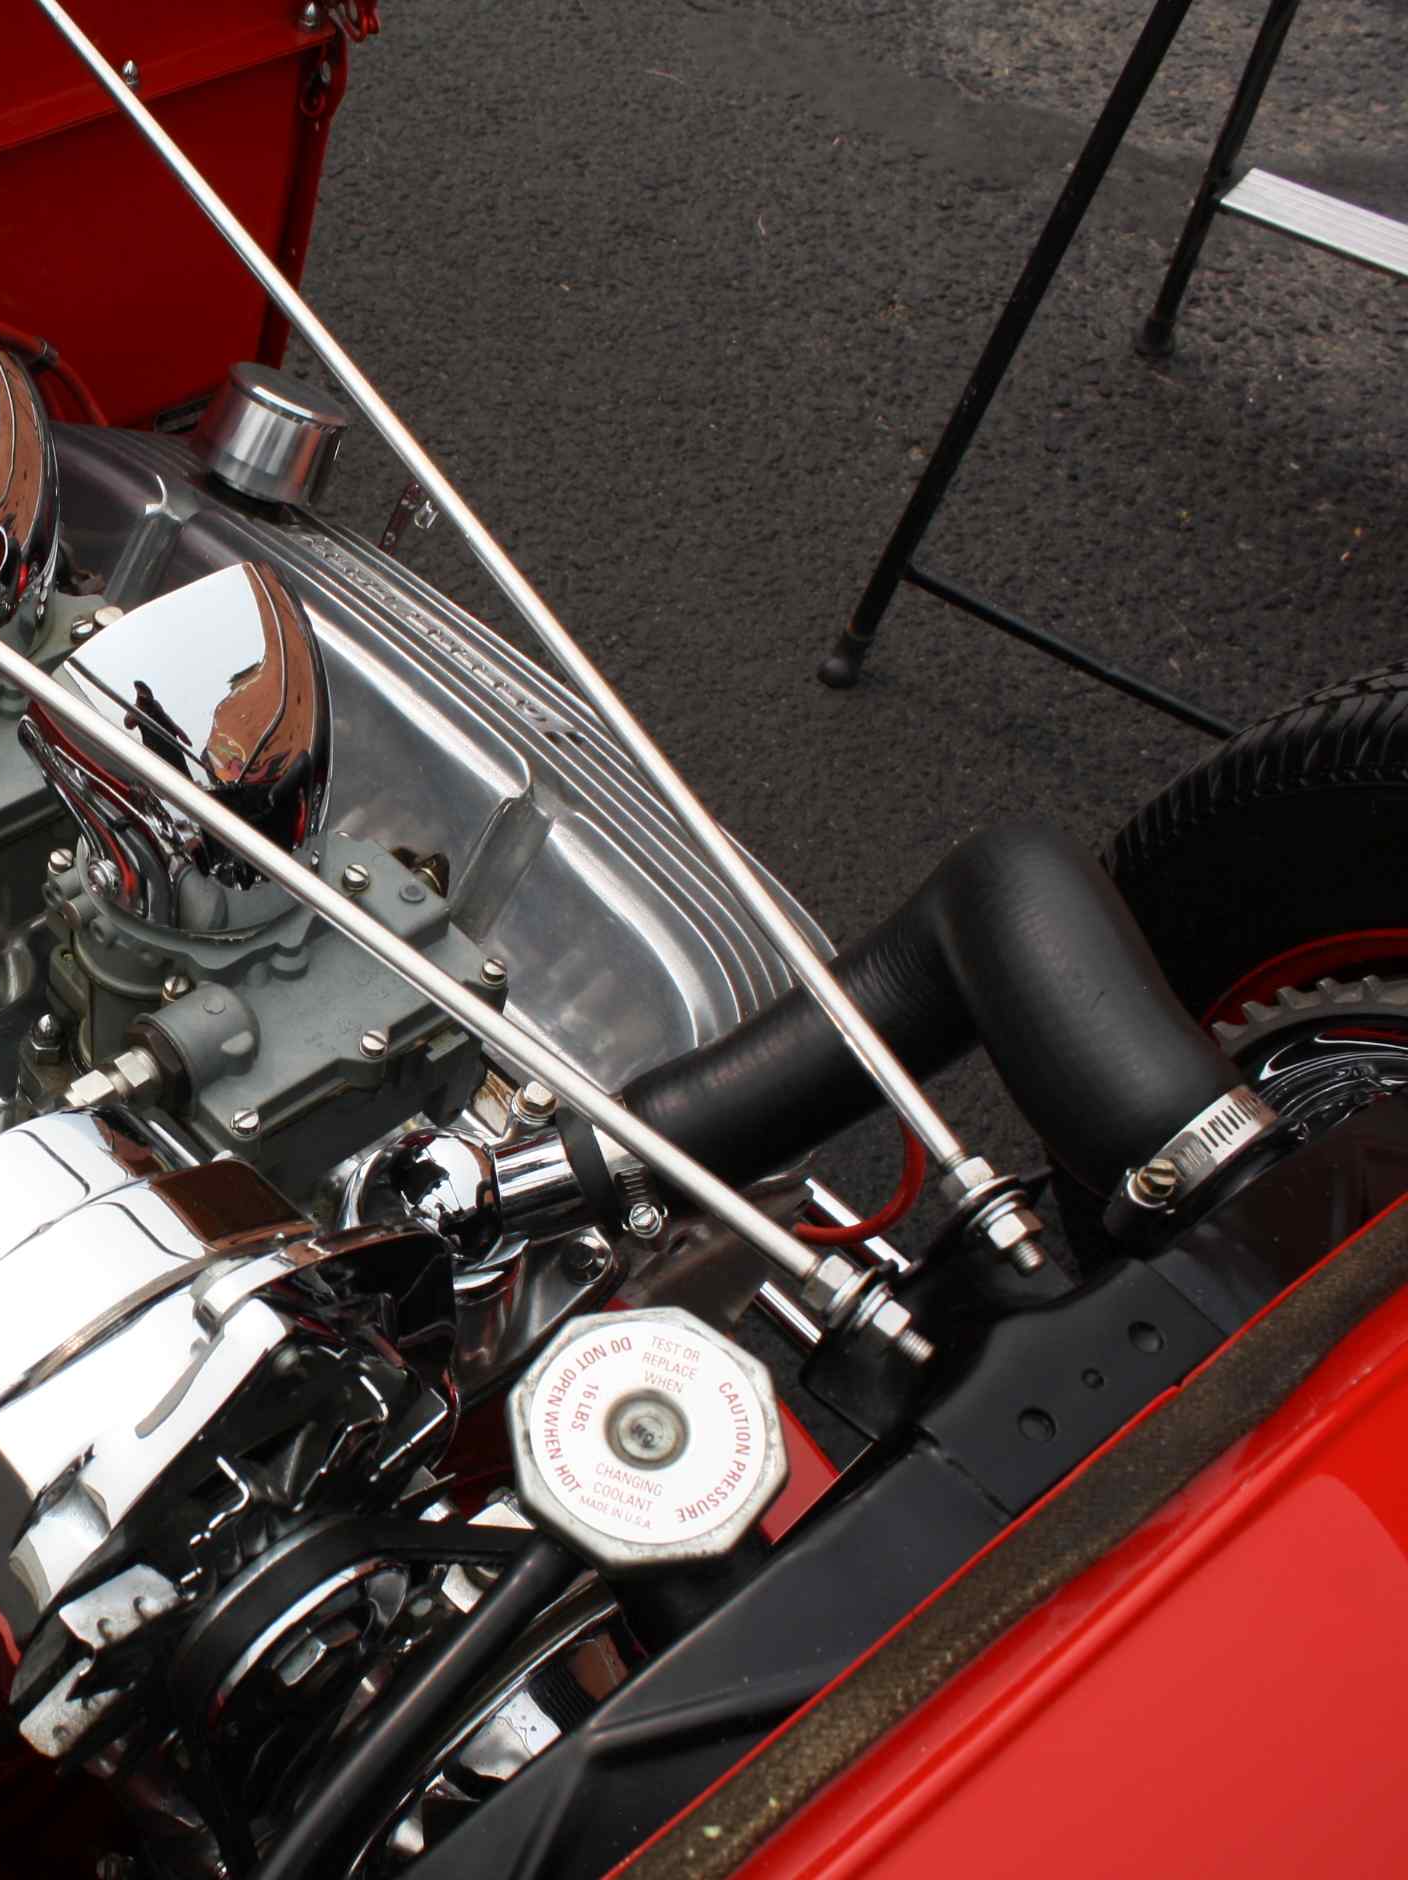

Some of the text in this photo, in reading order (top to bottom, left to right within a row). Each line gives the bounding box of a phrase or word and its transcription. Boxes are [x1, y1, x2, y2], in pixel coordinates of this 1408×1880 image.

[652, 1335, 700, 1362] TEST OR
[642, 1352, 697, 1380] REPLACE
[581, 1384, 599, 1400] 16
[644, 1370, 683, 1394] WHEN
[544, 1336, 632, 1493] DO NOT OPEN WHEN HOT
[675, 1382, 751, 1522] CAUTION PRESSURE
[595, 1462, 663, 1497] CHANGING
[578, 1495, 609, 1513] MADE
[610, 1507, 623, 1519] IN
[593, 1481, 653, 1512] COOLANT
